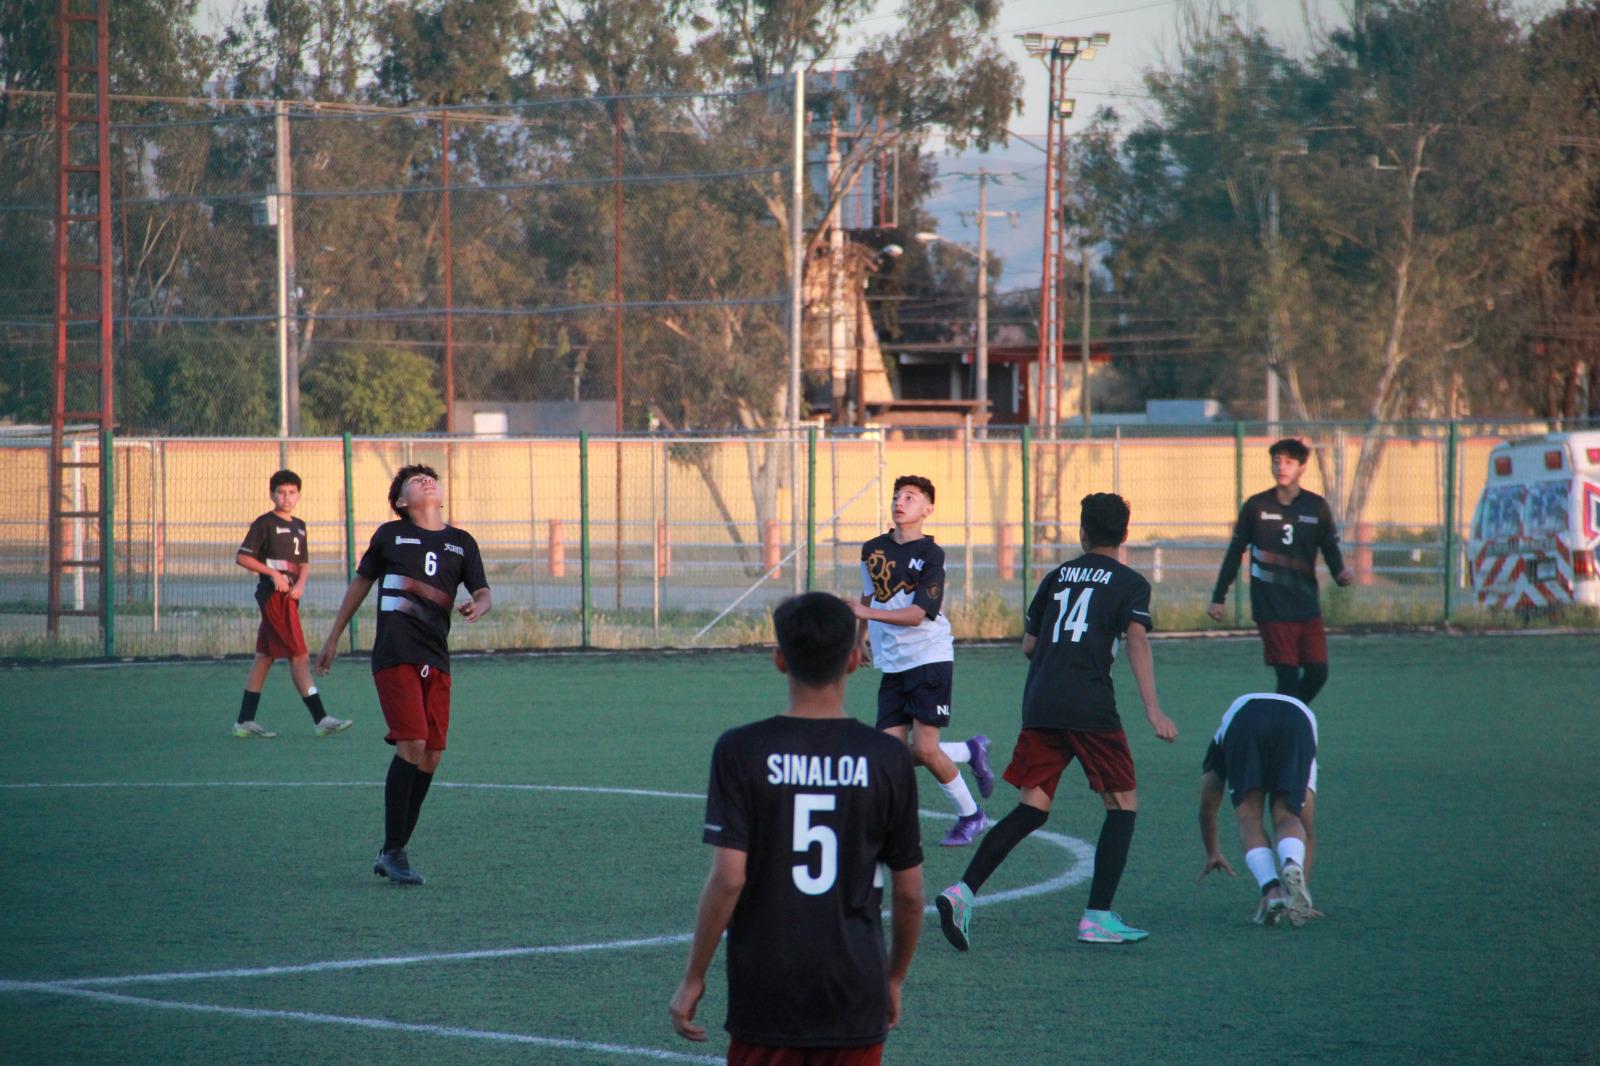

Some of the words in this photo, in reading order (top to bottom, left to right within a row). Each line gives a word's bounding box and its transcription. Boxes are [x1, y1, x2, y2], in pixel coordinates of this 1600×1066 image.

[293, 537, 300, 555] 2
[1282, 524, 1294, 545] 3
[424, 551, 438, 577] 6
[1058, 566, 1113, 585] SINALOA
[1052, 587, 1095, 643] 14
[767, 753, 869, 788] SINALOA
[792, 793, 838, 896] 5
